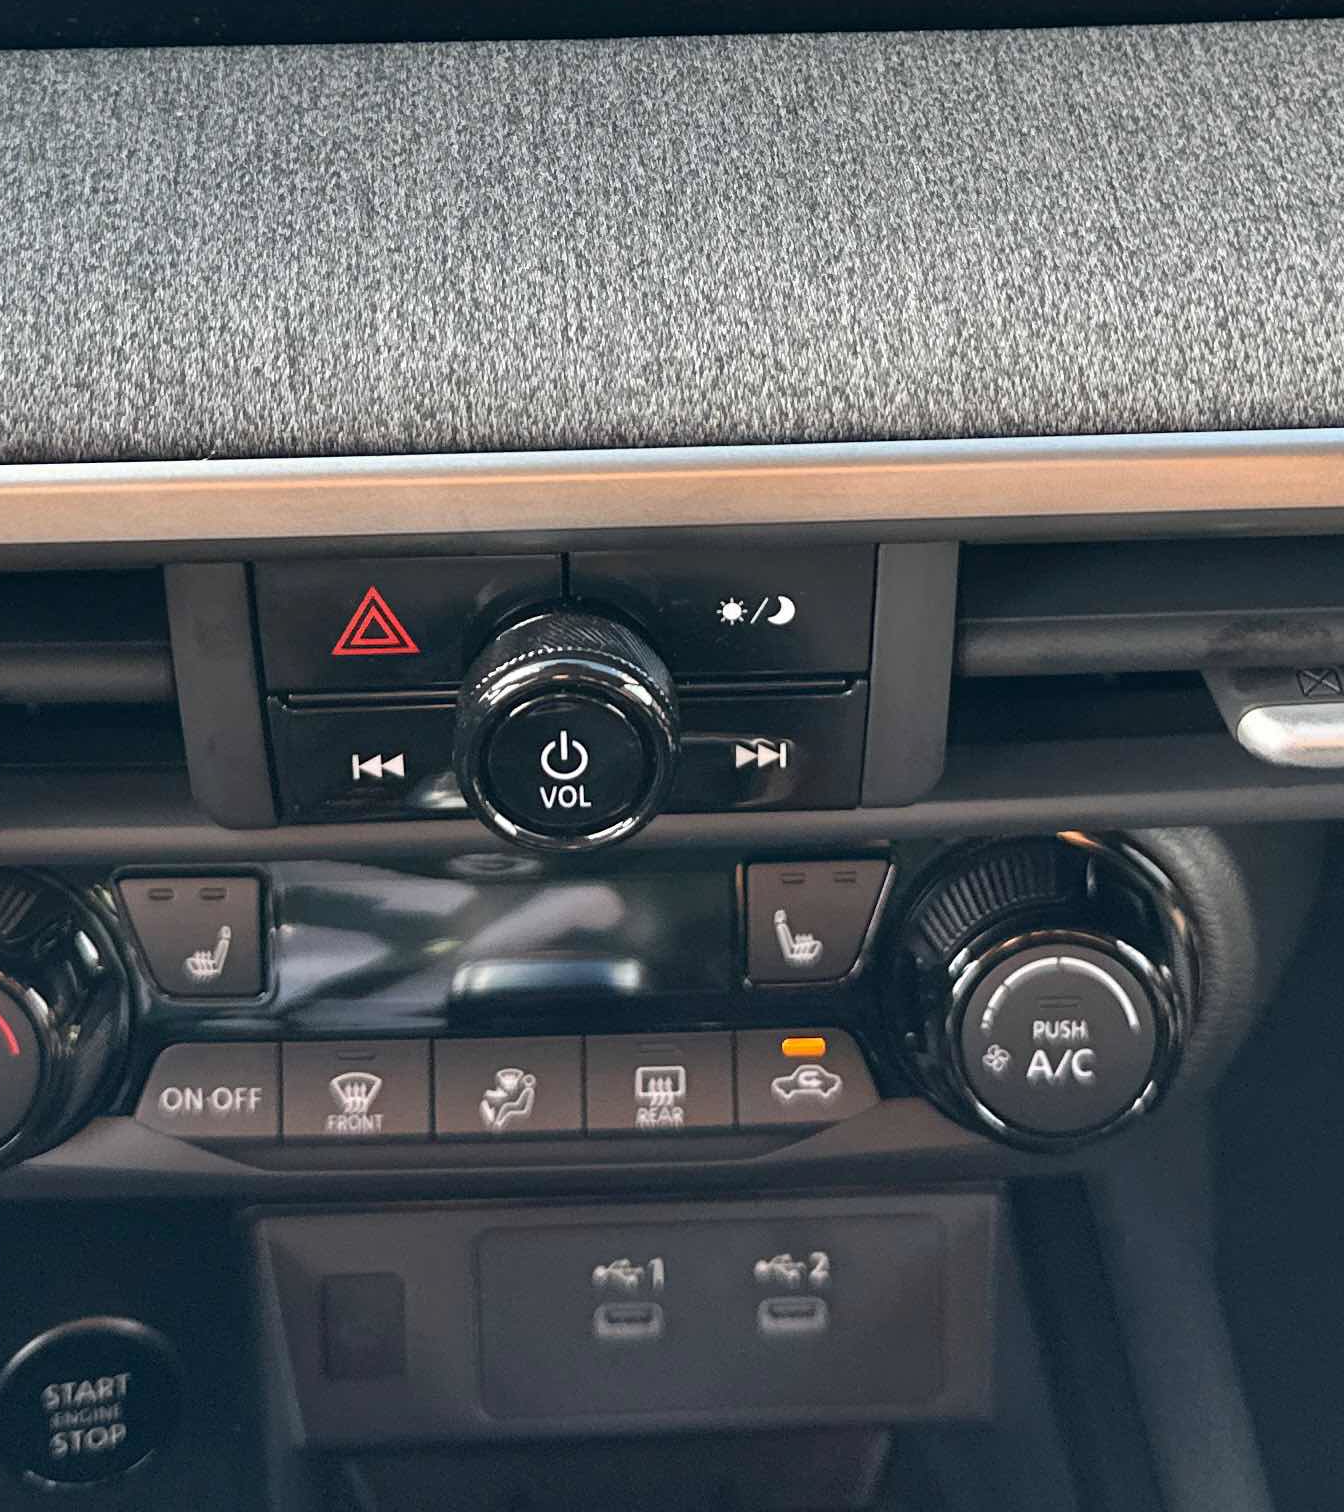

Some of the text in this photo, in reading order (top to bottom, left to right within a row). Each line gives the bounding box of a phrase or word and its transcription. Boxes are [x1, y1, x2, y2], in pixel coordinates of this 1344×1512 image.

[539, 785, 592, 809] VOL
[1032, 1018, 1089, 1040] PUSH
[1025, 1048, 1096, 1080] A/C
[325, 1112, 384, 1133] FRONT
[634, 1105, 686, 1128] REAR
[648, 1257, 665, 1290] 1
[808, 1251, 831, 1286] 2
[41, 1373, 130, 1410] START
[49, 1423, 127, 1459] STOP
